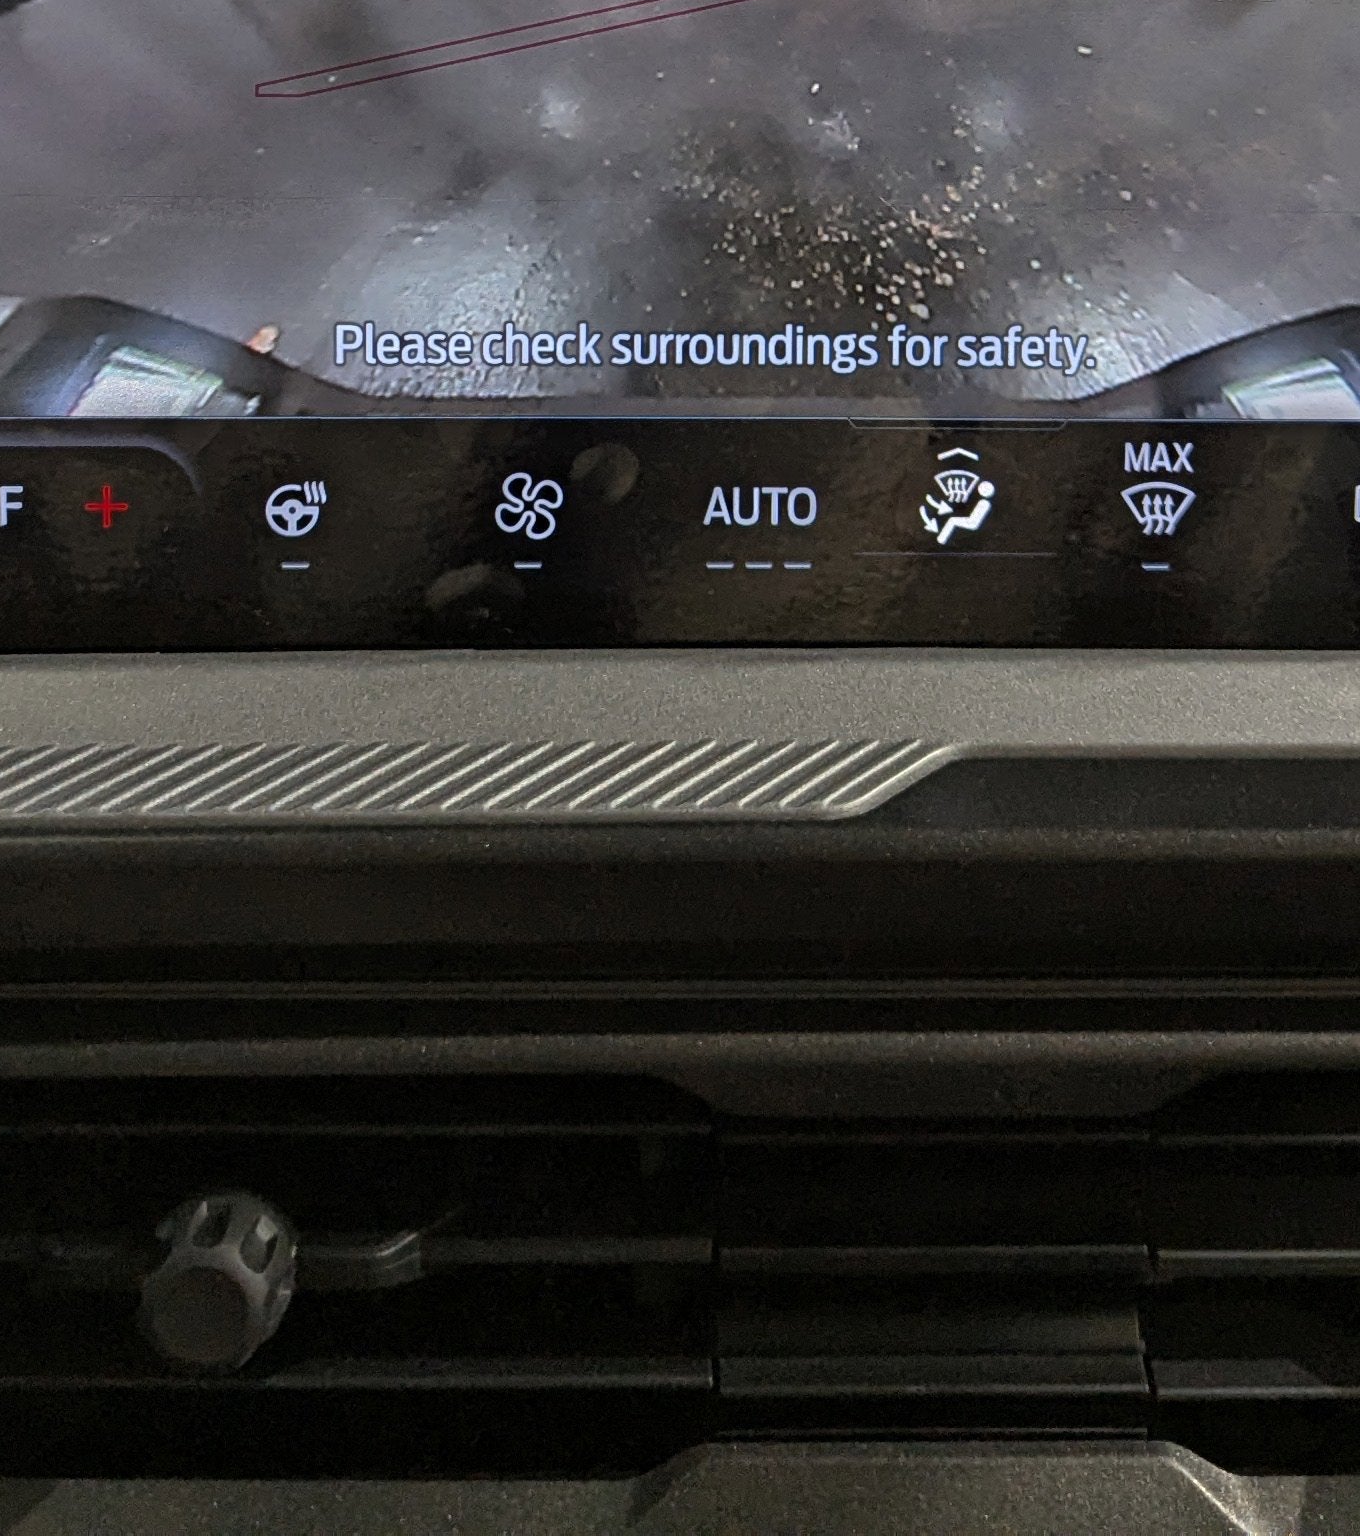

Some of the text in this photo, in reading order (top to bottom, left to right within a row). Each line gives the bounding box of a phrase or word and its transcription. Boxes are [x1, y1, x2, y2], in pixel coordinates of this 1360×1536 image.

[333, 323, 1098, 376] Please check surroundings for safety.
[1123, 441, 1195, 473] MAX
[703, 485, 818, 527] AUTO
